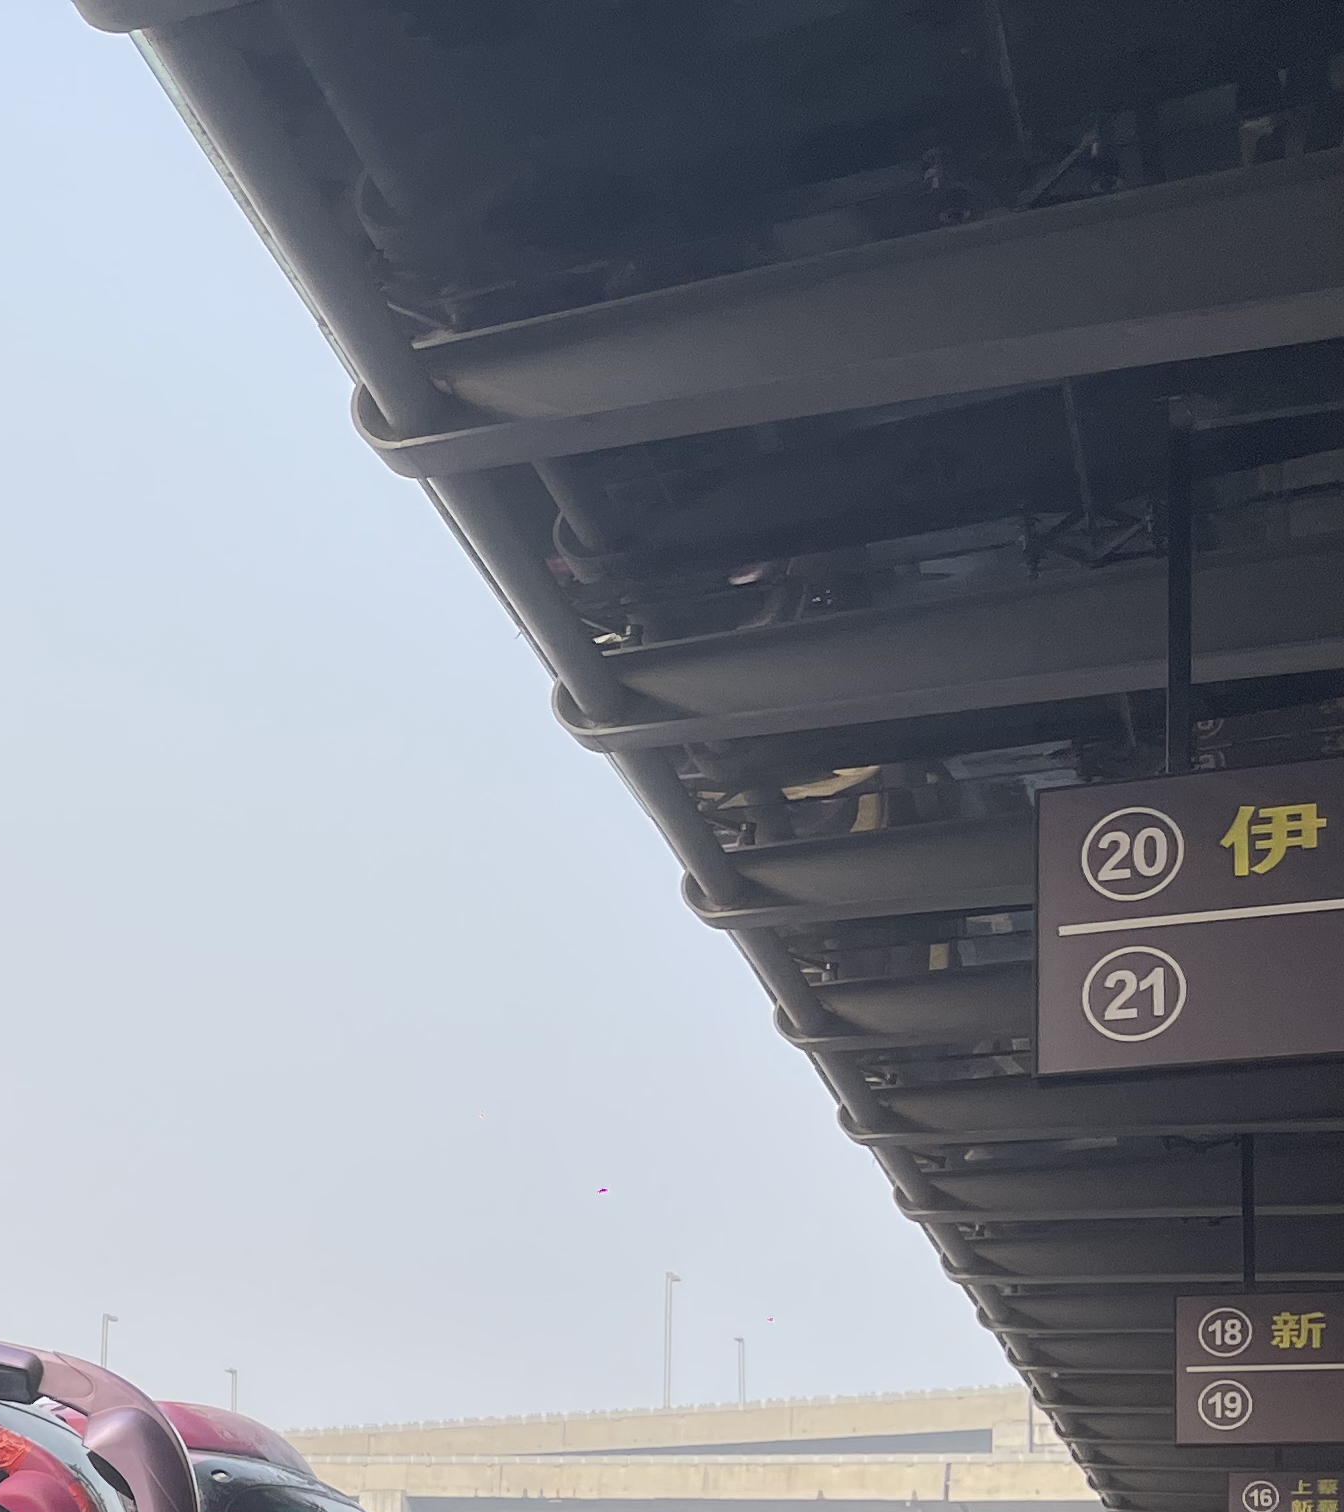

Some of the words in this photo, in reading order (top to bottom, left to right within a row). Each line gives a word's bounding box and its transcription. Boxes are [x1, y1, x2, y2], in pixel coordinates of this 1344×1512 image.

[1098, 827, 1168, 881] 20
[1220, 802, 1327, 876] 伊
[1103, 967, 1165, 1020] 21
[1208, 1319, 1242, 1345] 18
[1271, 1311, 1326, 1348] 新
[1207, 1391, 1242, 1418] 19
[1249, 1488, 1272, 1507] 16
